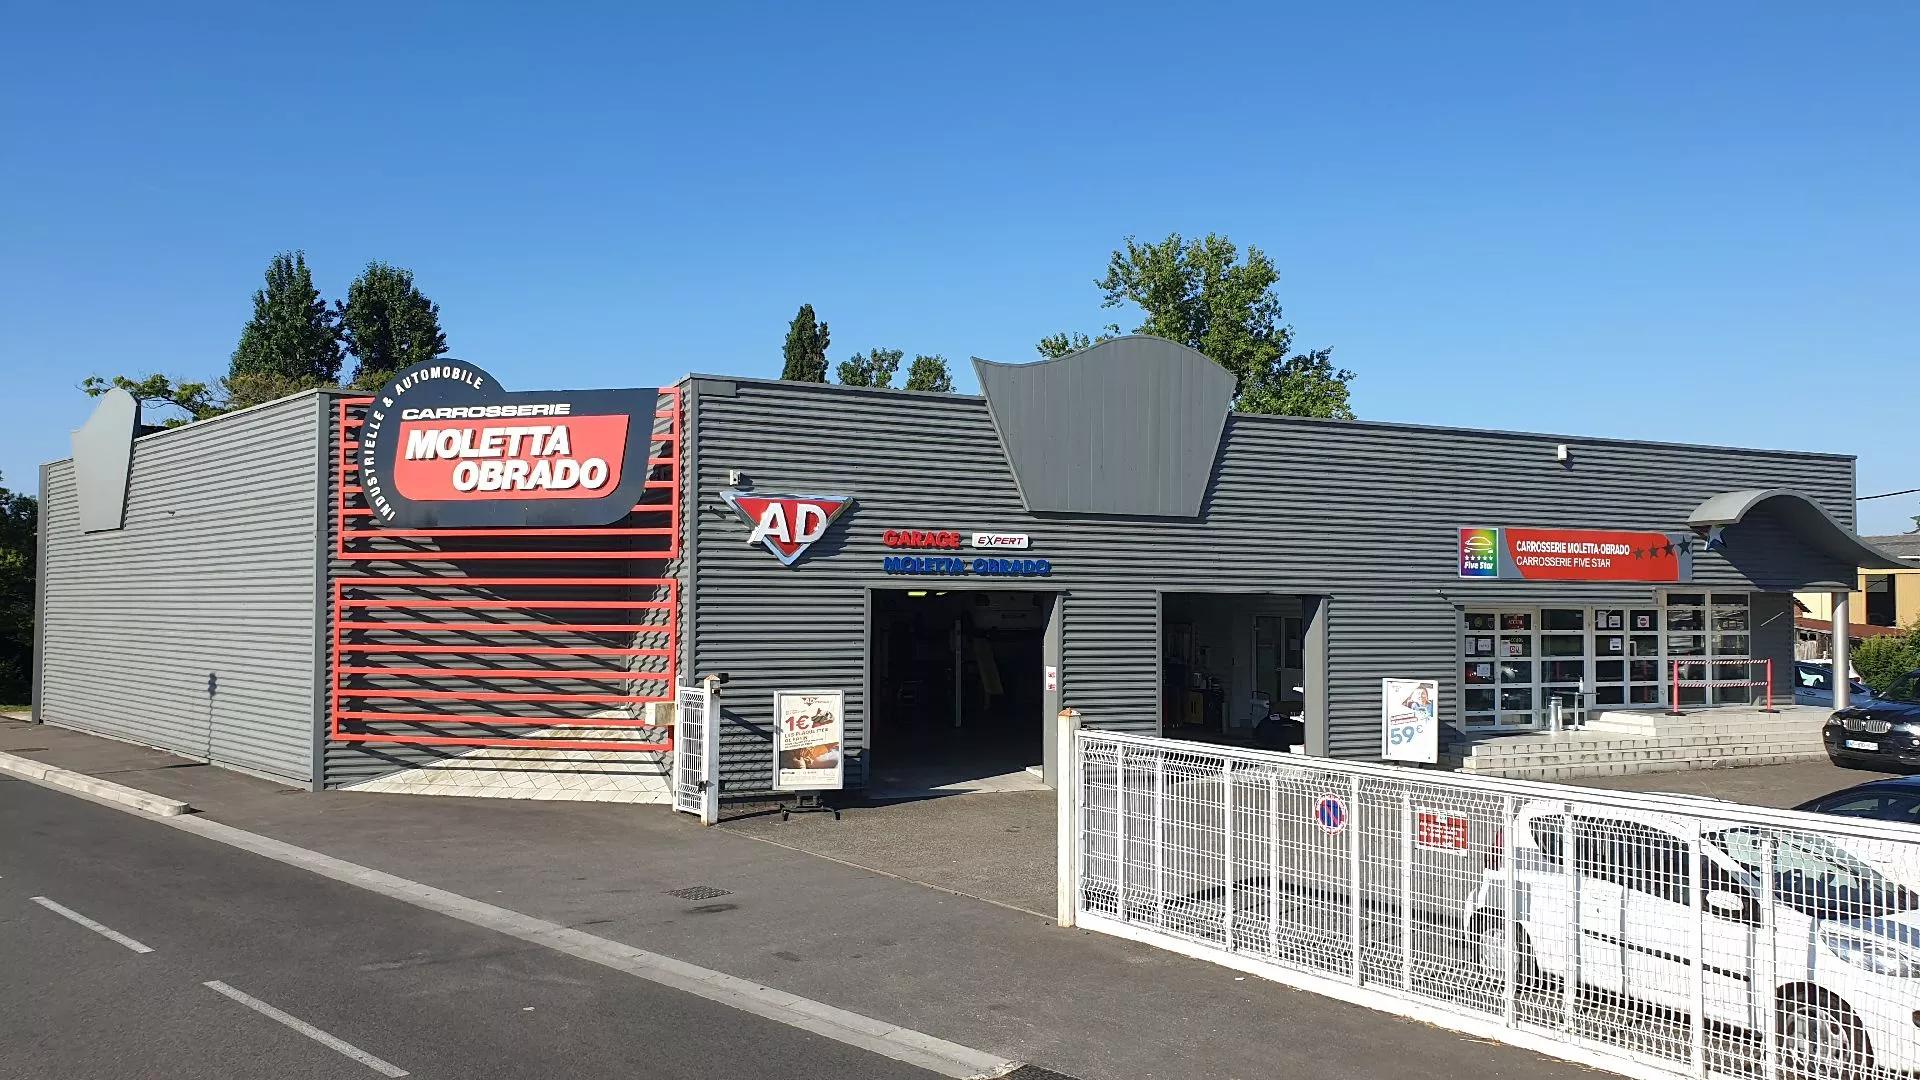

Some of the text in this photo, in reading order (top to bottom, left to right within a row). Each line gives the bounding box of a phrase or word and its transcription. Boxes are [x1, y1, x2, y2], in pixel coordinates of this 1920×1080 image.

[402, 403, 571, 420] CARROSSERIE
[364, 366, 484, 521] INDUSTRIELLE & AUTOMOBILE
[405, 425, 570, 460] MOLETTA
[452, 457, 609, 491] OBRADO
[747, 502, 828, 544] AD
[882, 530, 1024, 548] GARAGE EXPERT
[1516, 540, 1567, 553] CARROSSERIE
[883, 556, 1051, 576] MOLETTA OBRADO
[1464, 561, 1494, 570] Five Star
[1516, 555, 1611, 568] CARROSSERIE FIVE STAR
[785, 715, 809, 731] 1€
